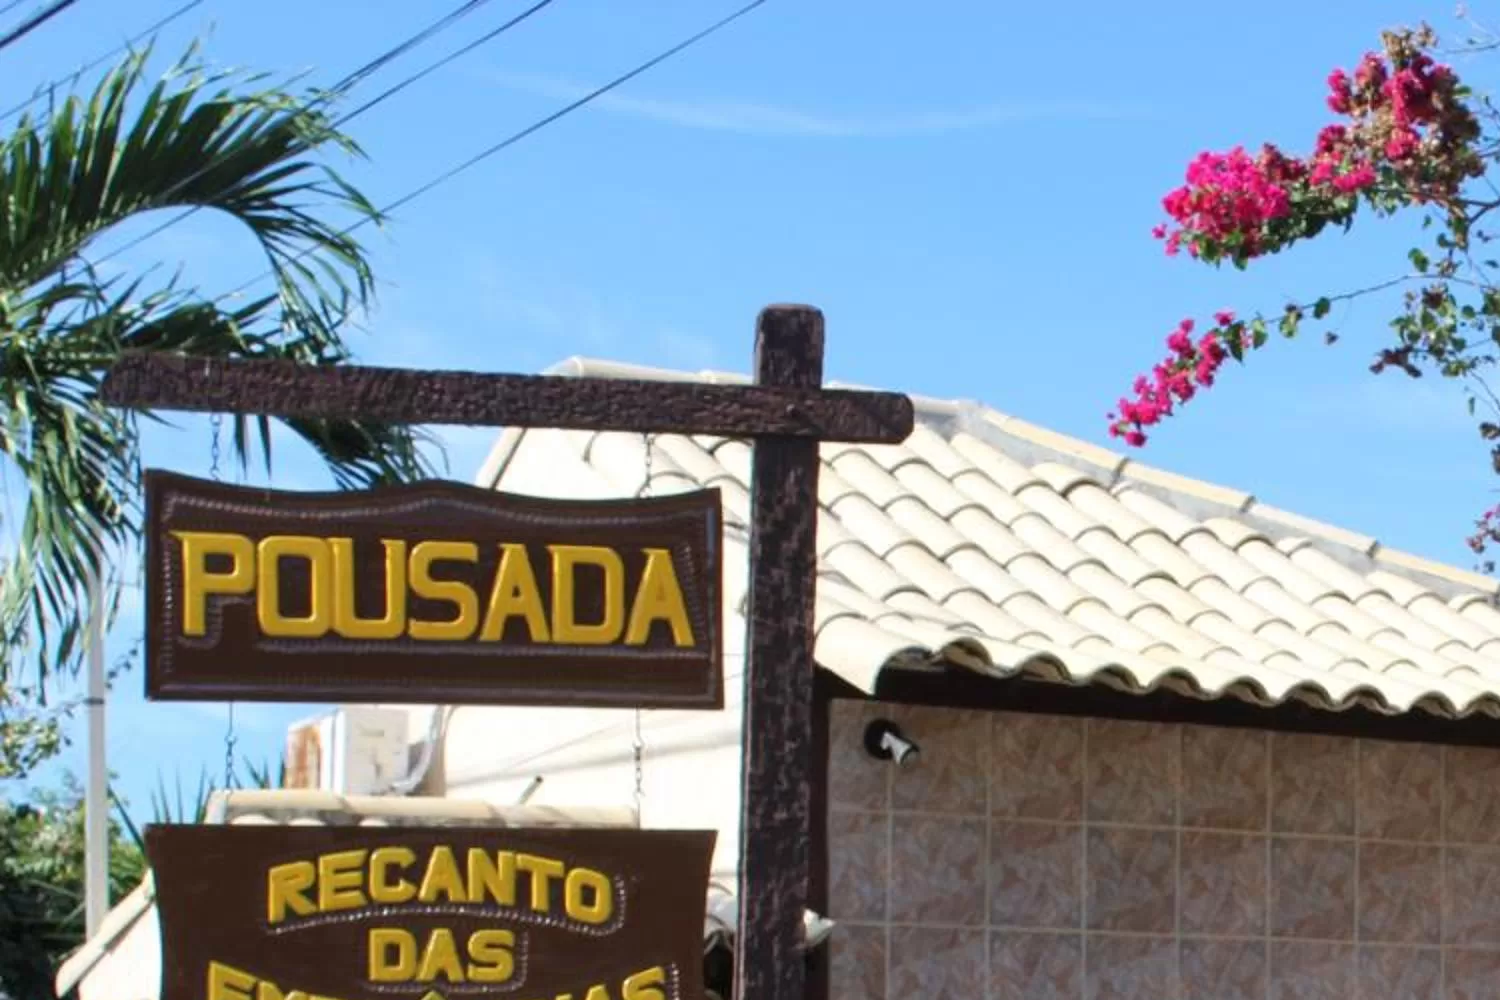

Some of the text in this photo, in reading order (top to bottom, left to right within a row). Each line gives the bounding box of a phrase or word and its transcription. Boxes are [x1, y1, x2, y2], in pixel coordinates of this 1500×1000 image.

[170, 530, 696, 648] POUSADA
[266, 845, 612, 925] RECANTO
[367, 928, 515, 983] DAS
